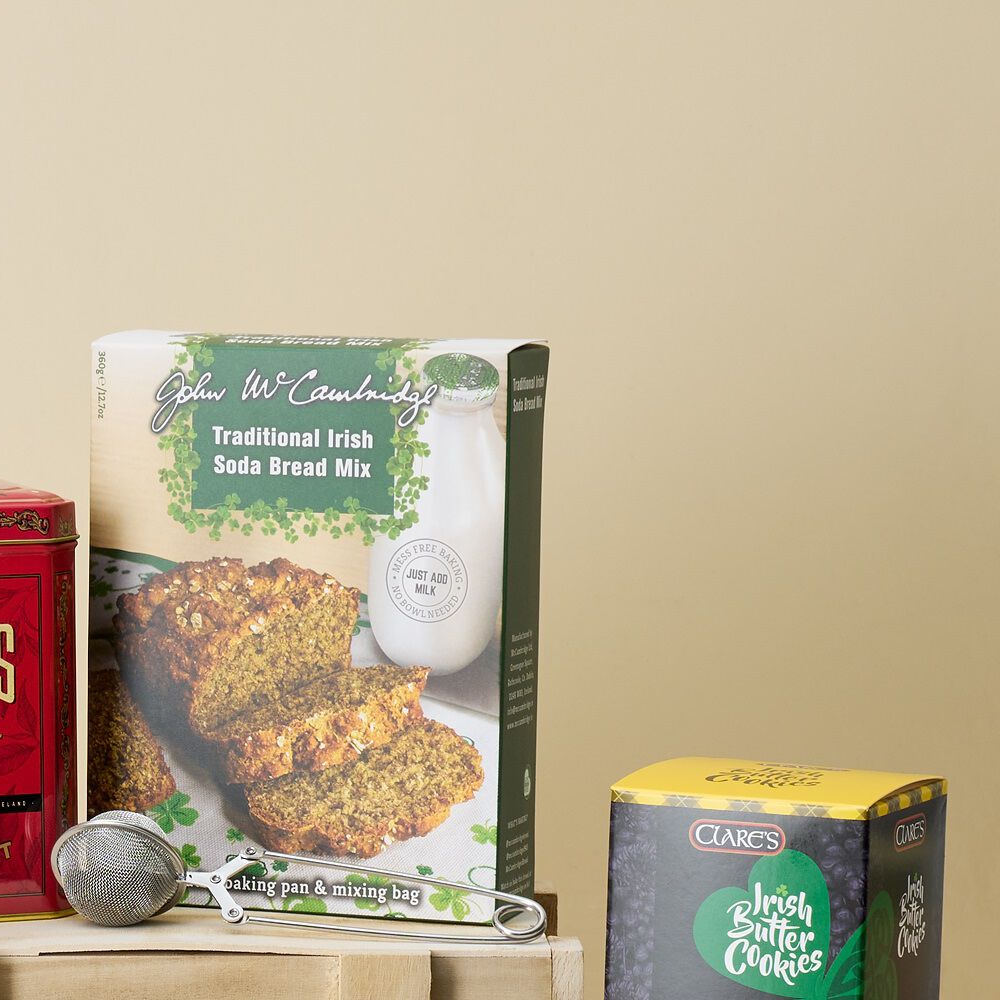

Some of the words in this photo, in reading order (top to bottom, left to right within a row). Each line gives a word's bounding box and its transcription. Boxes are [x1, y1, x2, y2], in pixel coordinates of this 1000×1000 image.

[96, 351, 106, 374] 360g
[151, 371, 226, 432] John
[212, 425, 320, 448] Traditional
[328, 428, 374, 449] Irish
[214, 454, 261, 475] Soda
[269, 456, 327, 477] Bread
[335, 458, 371, 479] Mix
[392, 549, 412, 573] MESS
[413, 544, 438, 554] FREE
[439, 548, 463, 583] BAKING
[406, 568, 428, 581] JUST
[431, 572, 448, 585] ADD
[392, 585, 403, 600] NO
[400, 598, 426, 618] BOWL
[427, 595, 459, 619] NEEDED
[415, 583, 437, 596] MILK
[695, 824, 779, 850] CLARE'S
[281, 881, 310, 898] pan
[314, 879, 328, 895] &
[332, 881, 387, 902] mixing
[392, 883, 421, 905] bag
[906, 875, 924, 904] Irish
[752, 882, 813, 928] Irish
[726, 900, 815, 953] Butter
[724, 938, 823, 986] Cookies
